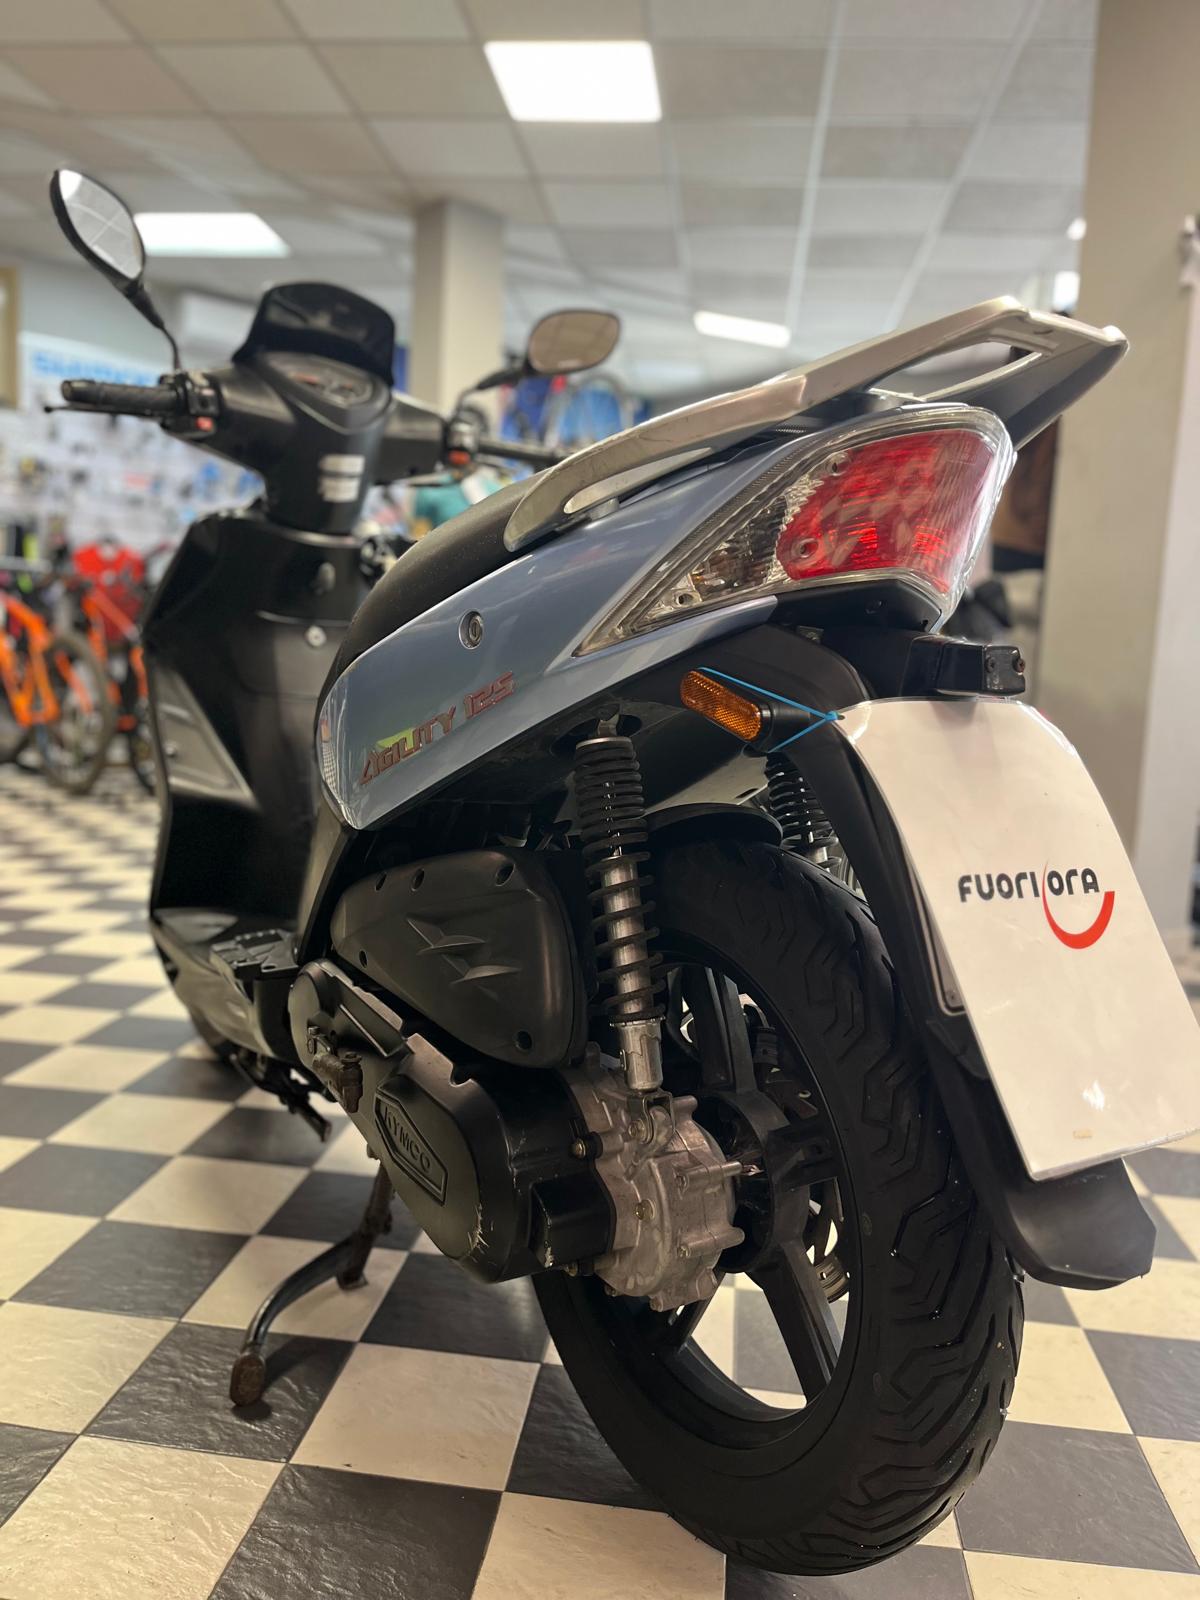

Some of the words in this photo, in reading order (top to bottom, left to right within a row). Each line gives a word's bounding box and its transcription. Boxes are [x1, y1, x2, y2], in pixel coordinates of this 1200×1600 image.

[359, 704, 457, 786] AGILITY
[463, 671, 515, 719] 125
[383, 1105, 432, 1175] KYMCO
